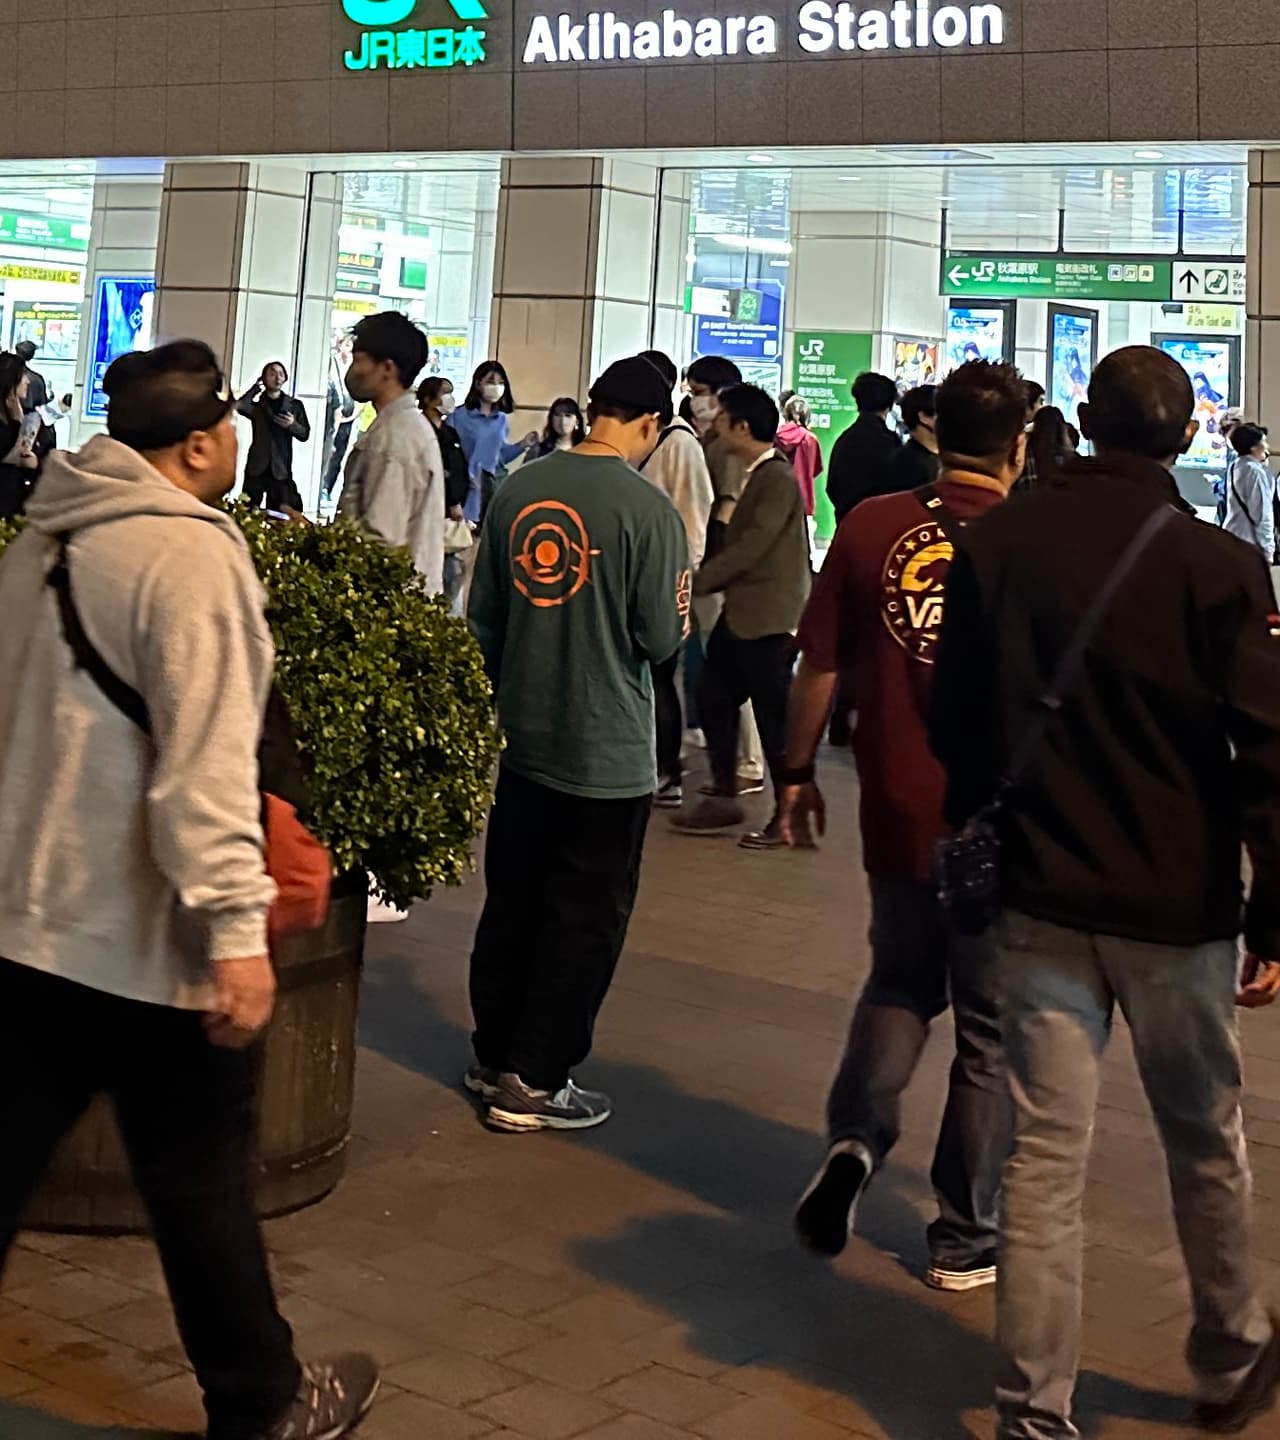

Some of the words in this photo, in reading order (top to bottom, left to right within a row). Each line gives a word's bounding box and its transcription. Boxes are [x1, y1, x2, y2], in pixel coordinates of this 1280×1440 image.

[343, 26, 487, 71] JR東日本
[522, 9, 778, 66] Akihabara
[971, 261, 995, 277] JR
[800, 339, 824, 356] JR
